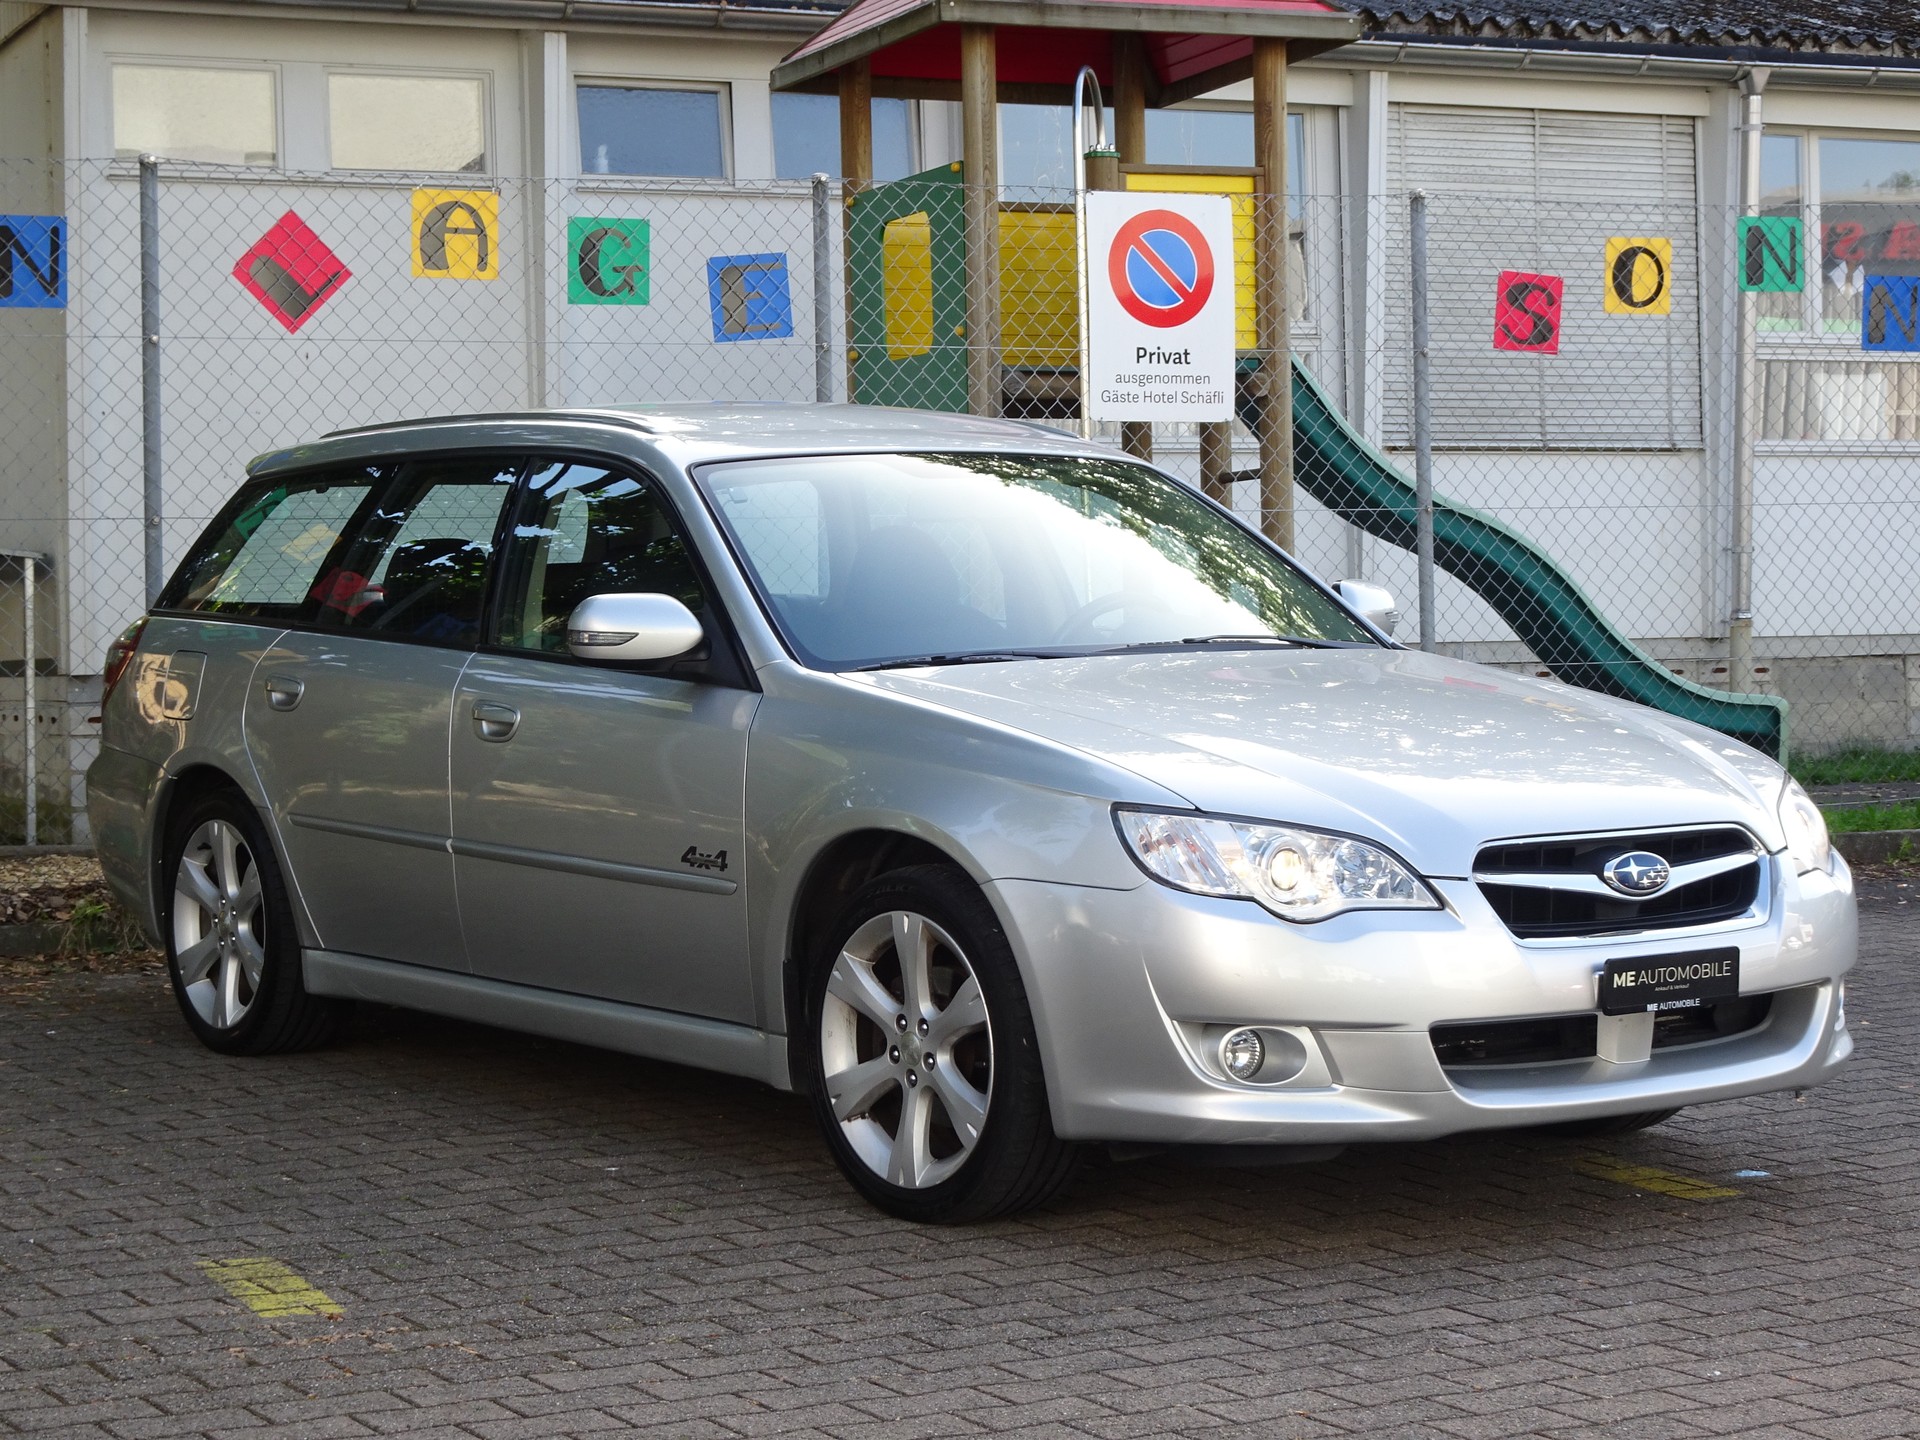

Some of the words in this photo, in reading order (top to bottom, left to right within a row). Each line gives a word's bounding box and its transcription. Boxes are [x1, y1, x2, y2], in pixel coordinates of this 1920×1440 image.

[420, 200, 489, 272] A
[578, 227, 643, 297] G
[720, 262, 783, 335] E
[1501, 282, 1555, 346] S
[1745, 225, 1797, 287] N
[1867, 283, 1919, 345] N
[1136, 346, 1191, 365] Privat
[1115, 373, 1211, 387] ausgenommen
[1101, 389, 1140, 404] Gäste
[1143, 391, 1178, 404] Hotel
[1180, 390, 1224, 404] Schäfli
[681, 845, 728, 872] 4x4
[1613, 970, 1636, 988] ME
[1637, 961, 1732, 985] AUTOMOBILE
[1646, 1003, 1658, 1012] ME
[1659, 998, 1701, 1011] AUTOMOBILE
